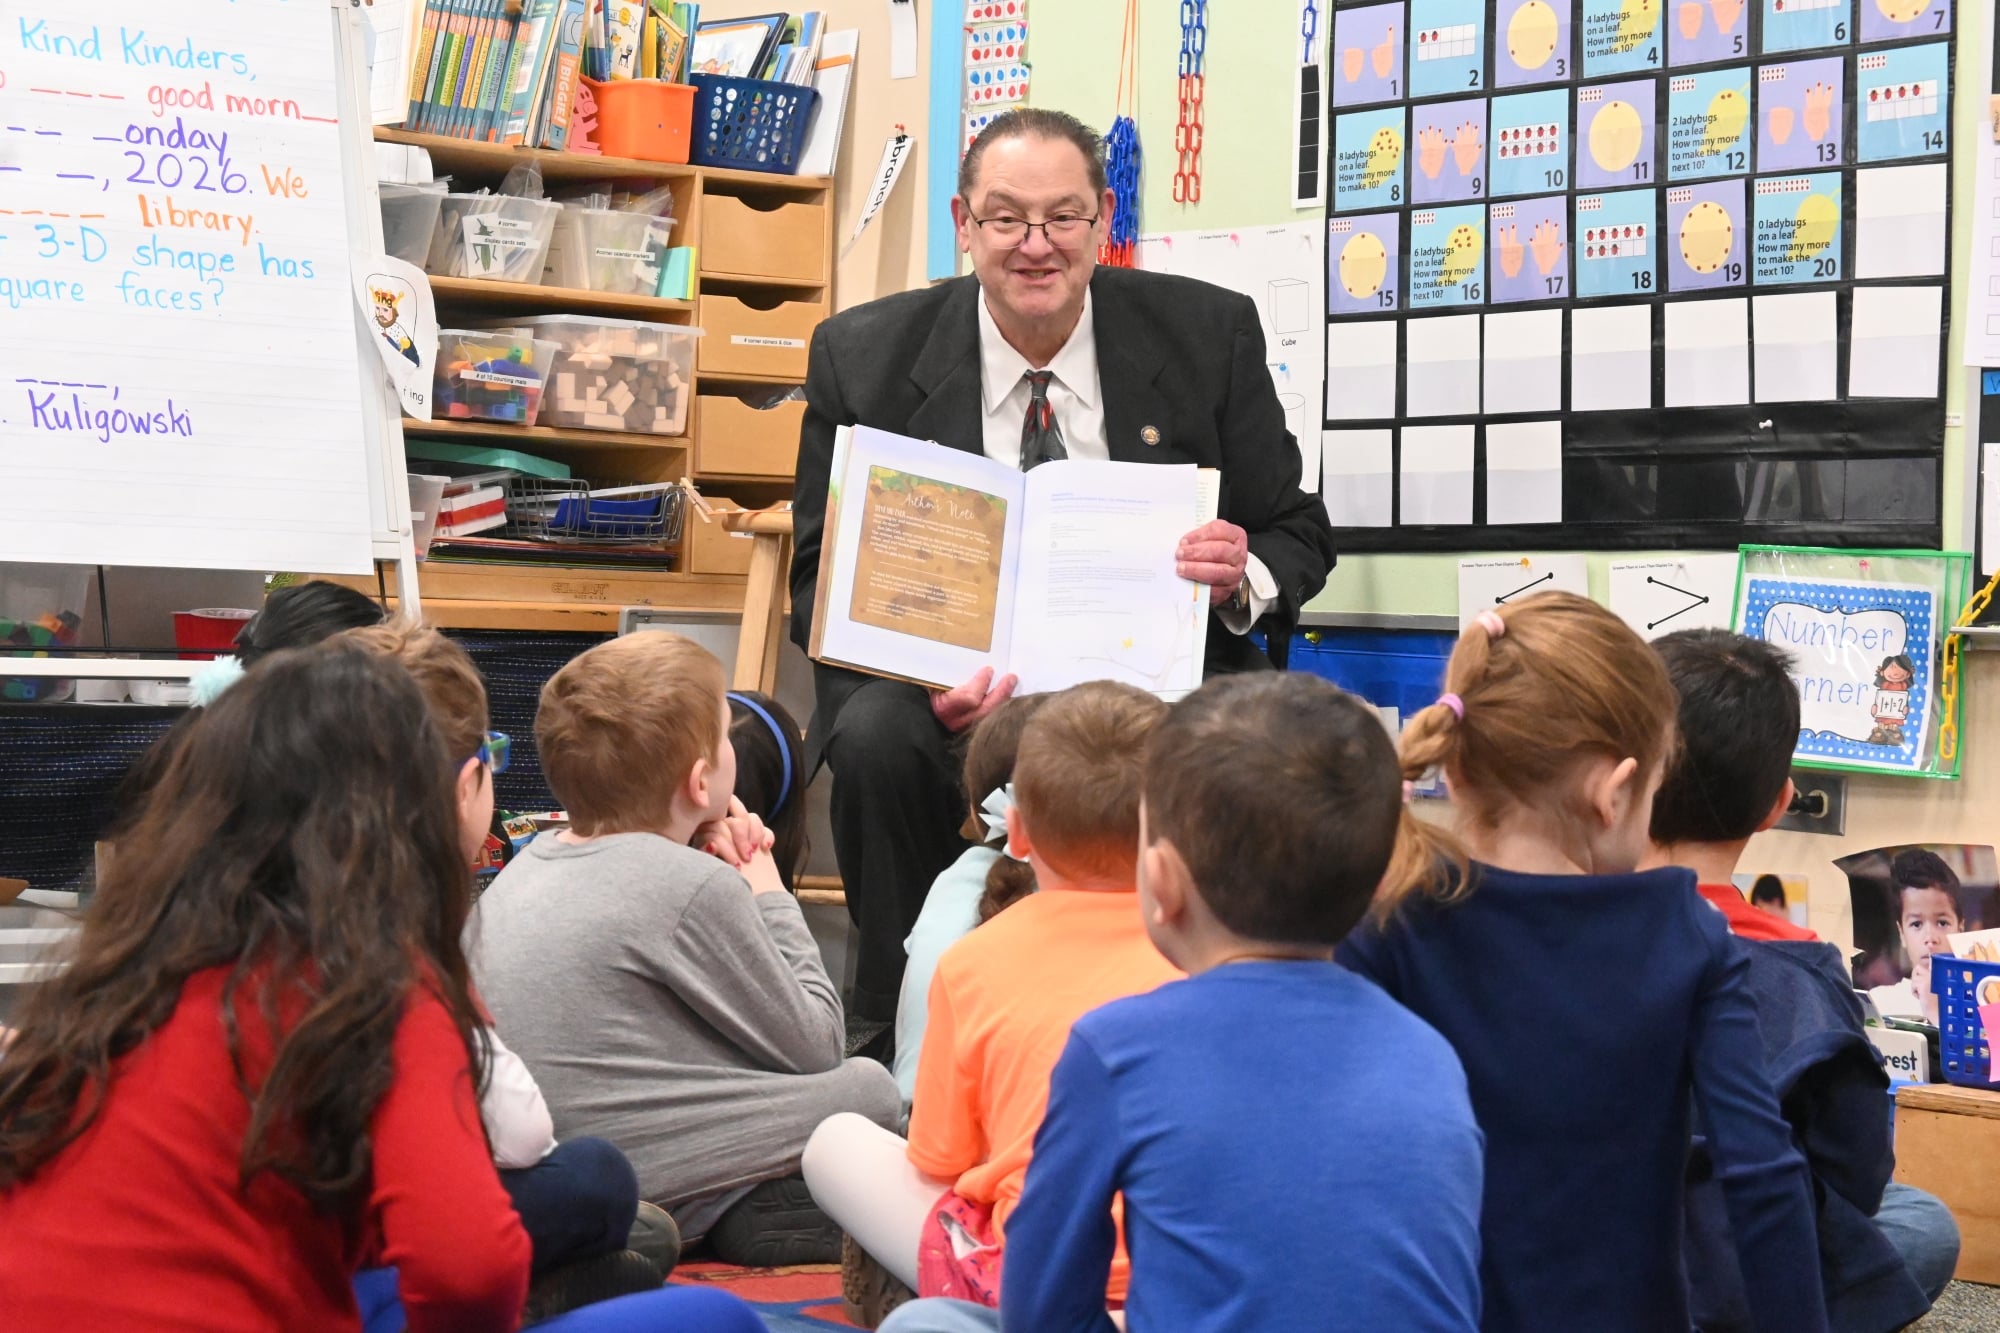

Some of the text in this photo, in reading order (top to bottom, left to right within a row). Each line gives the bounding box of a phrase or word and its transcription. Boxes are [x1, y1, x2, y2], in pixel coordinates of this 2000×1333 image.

[1587, 11, 1630, 24] 4 ladybugs
[1934, 10, 1946, 30] 7
[1606, 22, 1622, 33] leaf.
[1835, 22, 1846, 41] 6
[1587, 31, 1652, 47] How many more
[1733, 35, 1743, 54] 5
[19, 16, 257, 81] Kind Kinders,
[1597, 46, 1618, 56] make
[1621, 43, 1633, 53] 10?
[1646, 46, 1658, 65] 4
[1556, 58, 1566, 77] 3
[1390, 79, 1398, 96] 1
[1469, 70, 1479, 87] 2
[147, 81, 214, 118] good
[1673, 113, 1717, 126] 2 ladybugs
[1692, 125, 1709, 135] leaf.
[1672, 135, 1739, 149] How many more
[1922, 130, 1944, 150] 14
[1345, 150, 1376, 160] ladybugs
[1683, 149, 1704, 159] make
[1707, 147, 1720, 156] the
[1725, 151, 1745, 171] 12
[1816, 143, 1836, 162] 13
[1355, 160, 1369, 169] leaf.
[1633, 161, 1649, 180] 11
[1672, 160, 1705, 172] next 10?
[124, 151, 308, 199] 2026. We
[874, 141, 905, 213] branch
[1356, 172, 1375, 180] many
[1377, 169, 1396, 177] more
[1545, 169, 1564, 187] 10
[1348, 182, 1366, 191] make
[1369, 180, 1379, 189] 10?
[1391, 184, 1400, 202] 8
[1472, 177, 1482, 195] 9
[138, 193, 260, 246] library.
[1759, 218, 1806, 229] 0 ladybugs
[1779, 229, 1797, 240] leaf.
[34, 223, 314, 282] 3-D shape has
[1421, 246, 1454, 257] ladybugs
[1758, 241, 1830, 253] How many more
[1431, 257, 1447, 266] leaf.
[1769, 254, 1793, 264] make
[1795, 253, 1810, 262] the
[1414, 267, 1475, 278] How many more
[1723, 263, 1742, 282] 19
[1758, 265, 1794, 276] next 10?
[1813, 258, 1837, 278] 20
[1423, 279, 1442, 288] make
[1444, 278, 1457, 286] the
[1546, 276, 1564, 295] 17
[1632, 271, 1652, 290] 18
[115, 270, 225, 318] faces?
[1377, 290, 1394, 308] 15
[1414, 290, 1443, 300] next 10?
[1462, 282, 1481, 301] 16
[1281, 338, 1297, 347] Cube
[1769, 612, 1893, 651] Number
[1794, 677, 1869, 706] rner
